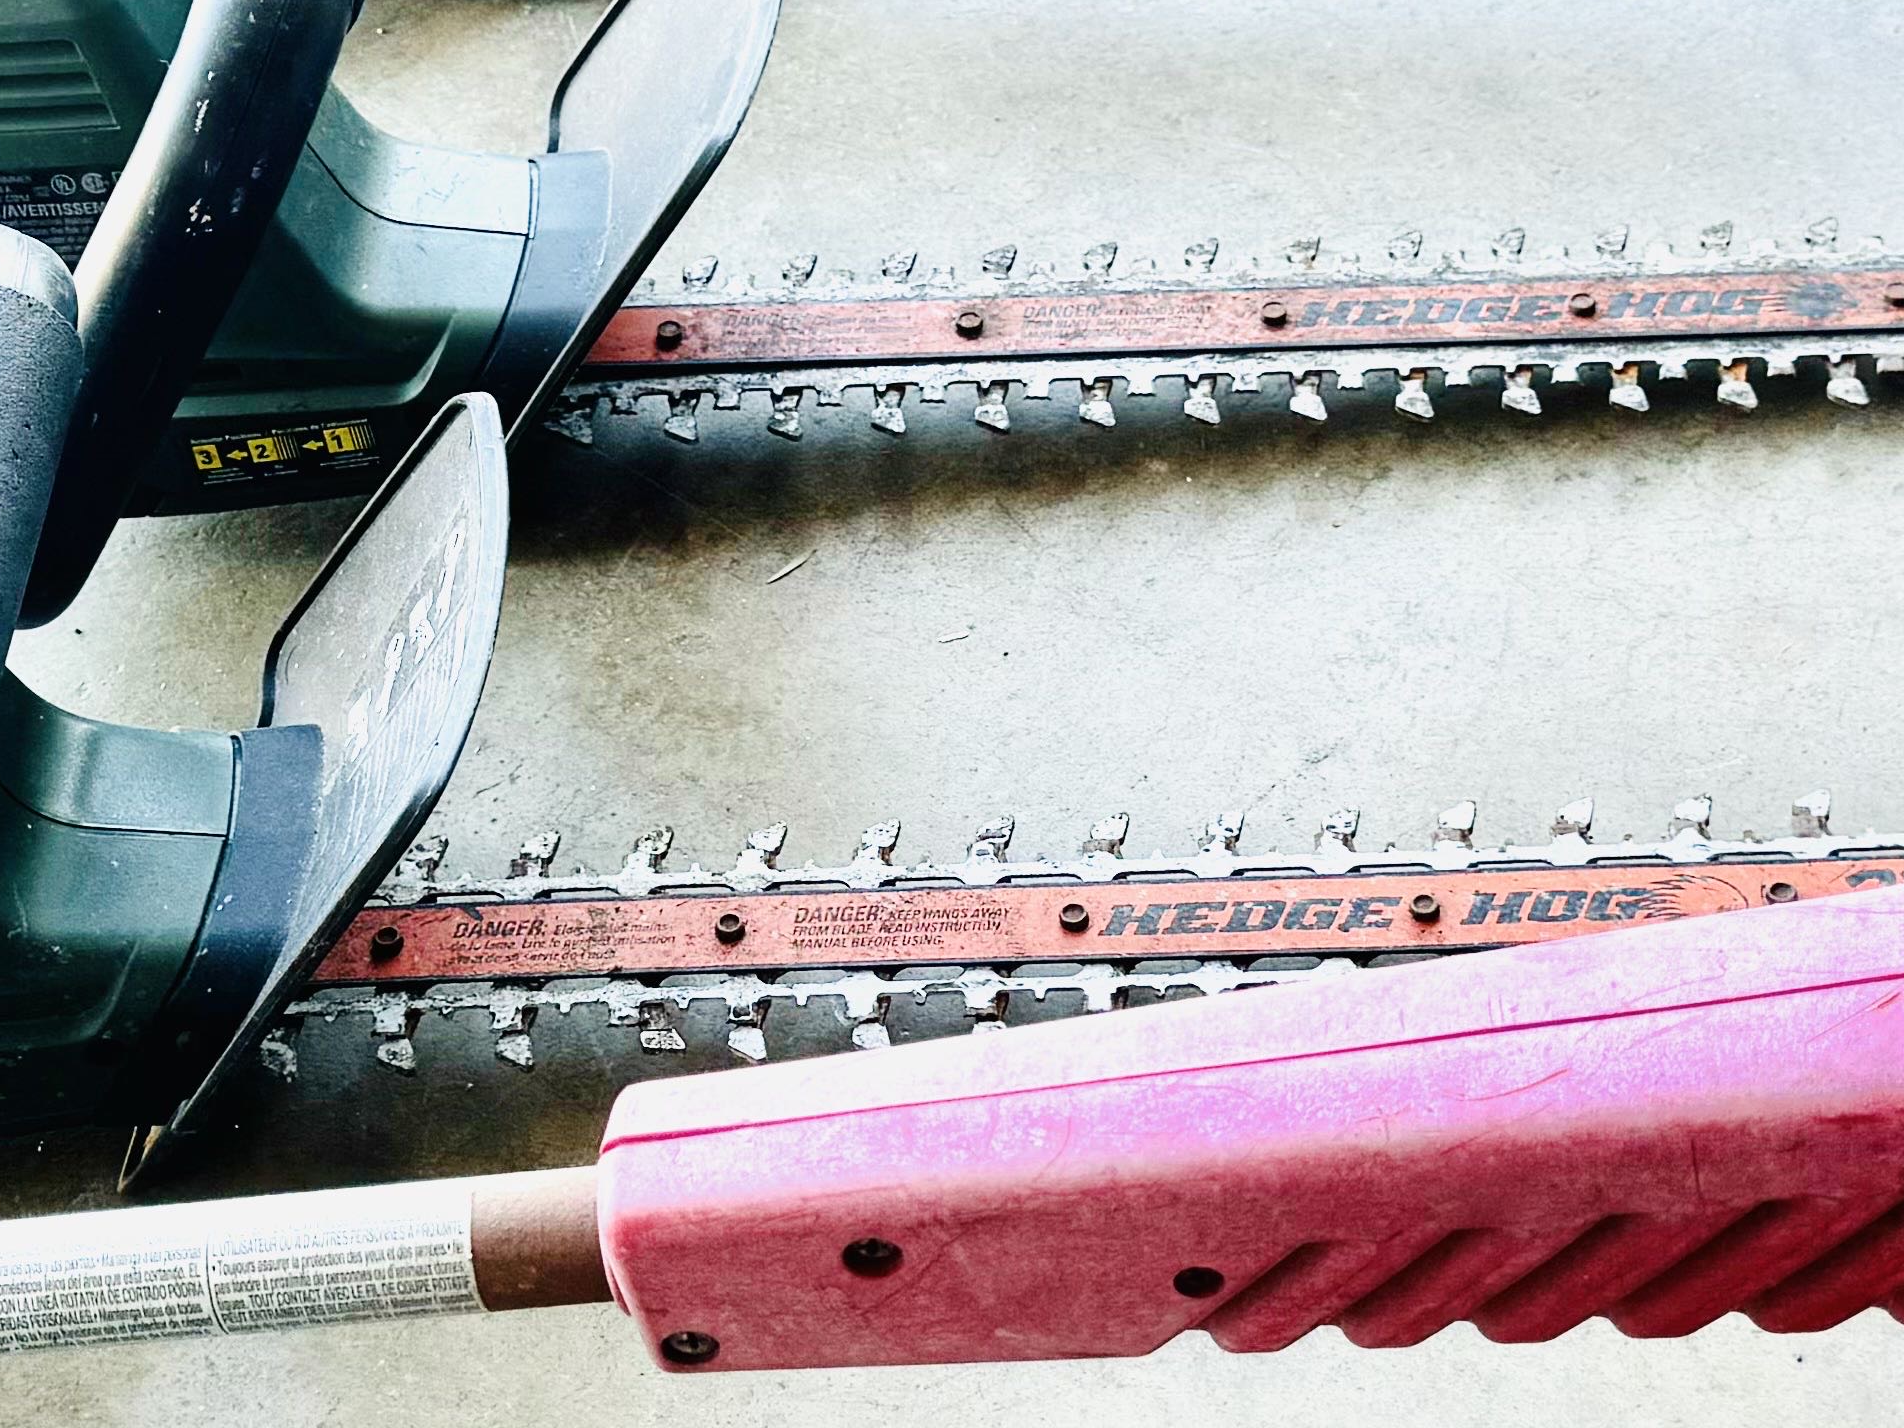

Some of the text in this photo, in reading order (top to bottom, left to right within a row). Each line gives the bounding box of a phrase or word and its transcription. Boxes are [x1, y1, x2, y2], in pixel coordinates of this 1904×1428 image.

[1299, 288, 1767, 329] HEDGE HOG
[198, 450, 213, 465] 3
[254, 444, 270, 460] 2
[795, 904, 1012, 924] DANGER: KEEP HANDS AWAY
[1097, 885, 1653, 938] HEDGE HOG
[453, 919, 548, 939] DANGER:
[792, 924, 829, 937] FROM
[878, 920, 912, 934] READ
[792, 932, 946, 950] MANUAL BEFORE USING.
[217, 1249, 387, 1278] Toujours assurer la protection des yeux
[67, 1273, 81, 1290] del
[104, 1274, 122, 1290] que
[188, 1262, 201, 1278] EL
[214, 1267, 386, 1299] pas tondre de personnes ou
[17, 1296, 31, 1313] LA
[59, 1289, 108, 1310] ROTATIVA
[107, 1287, 122, 1305] DE
[122, 1284, 167, 1303] CORTADO
[248, 1274, 471, 1309] TOUT CONTACT AVEC LE DE COUPE ROTATIF
[98, 1307, 142, 1322] Mantenga
[220, 1310, 248, 1325] PEUT
[15, 1332, 29, 1344] No
